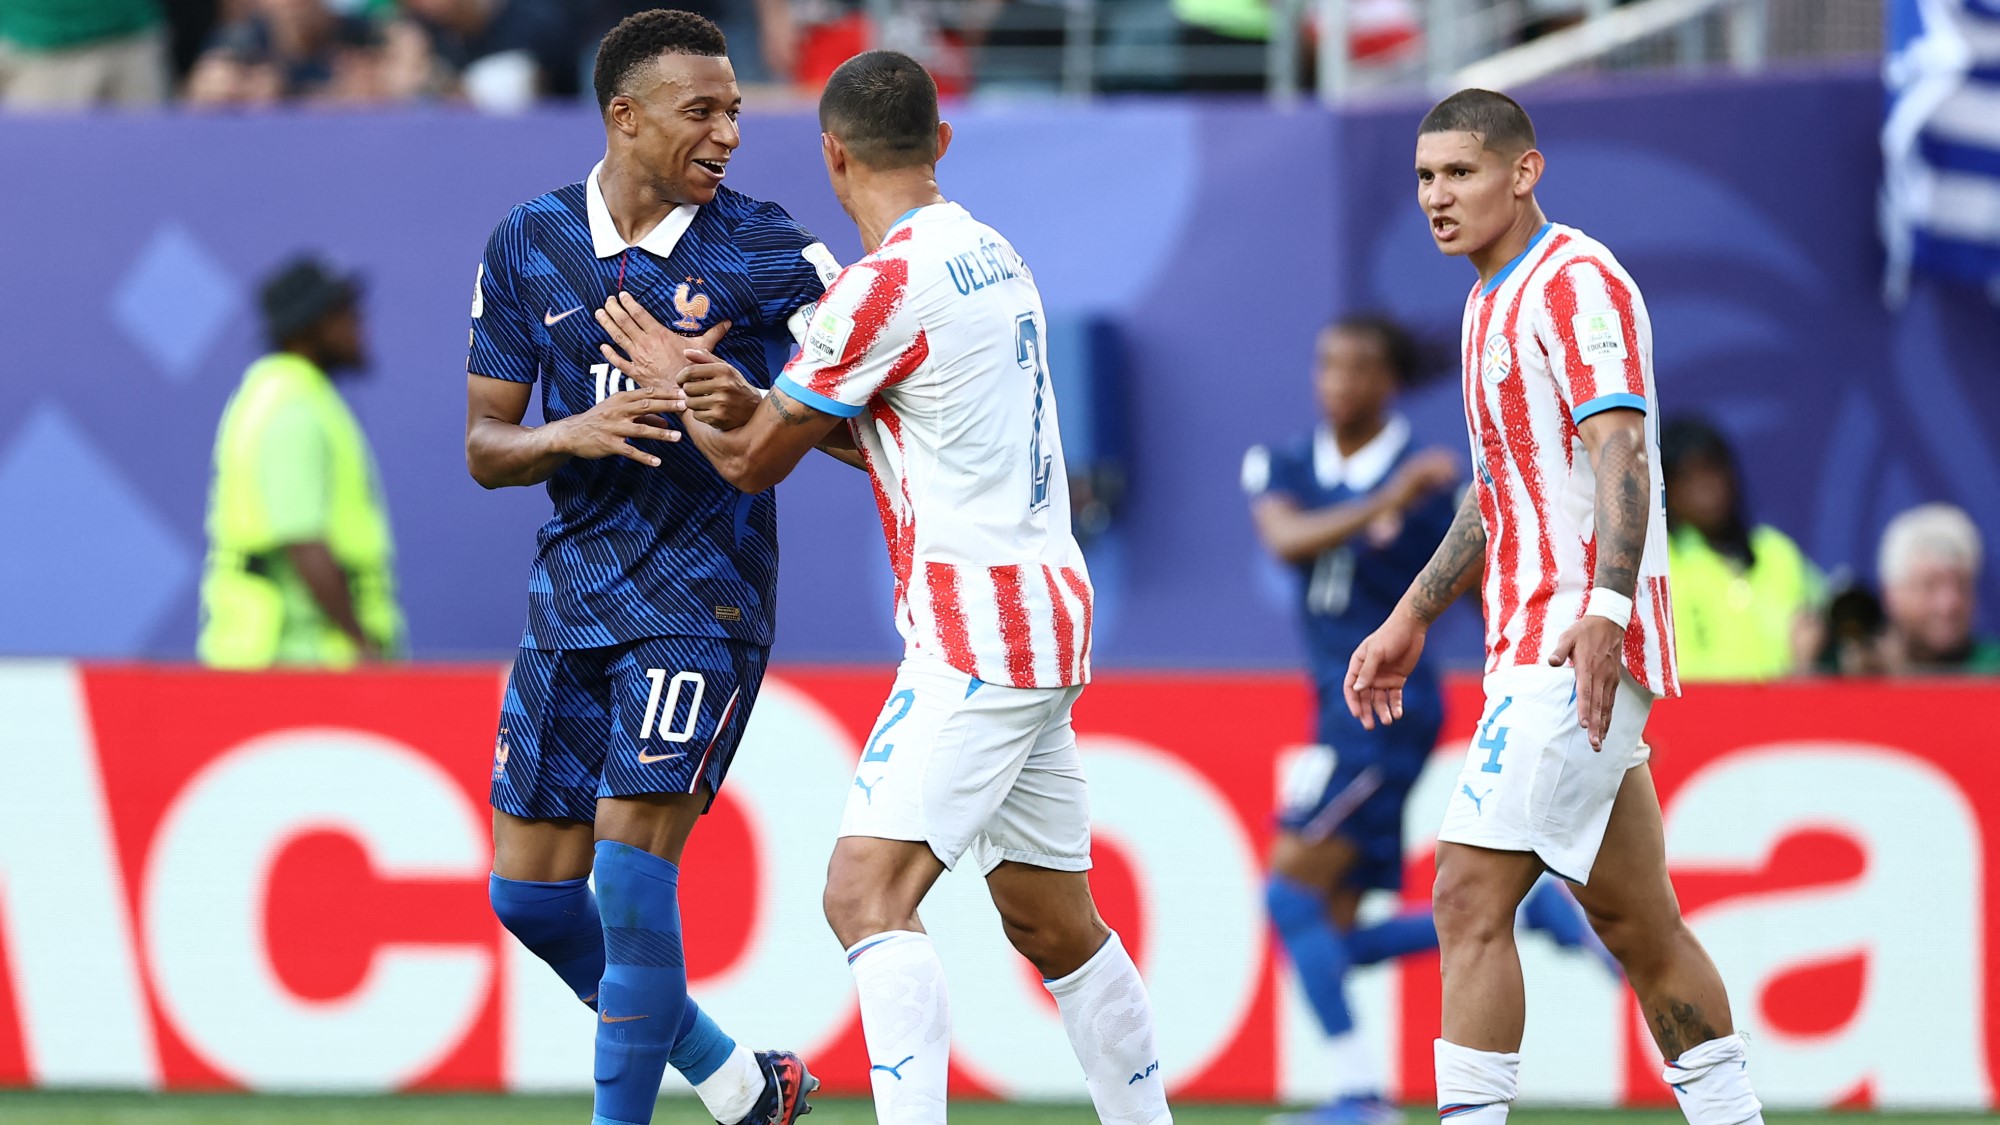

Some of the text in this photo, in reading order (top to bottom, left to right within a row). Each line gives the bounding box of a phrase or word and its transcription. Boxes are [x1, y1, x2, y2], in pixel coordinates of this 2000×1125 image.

[801, 302, 818, 319] FOO
[639, 668, 706, 743] 10
[863, 687, 915, 762] 2
[1478, 696, 1513, 774] 4
